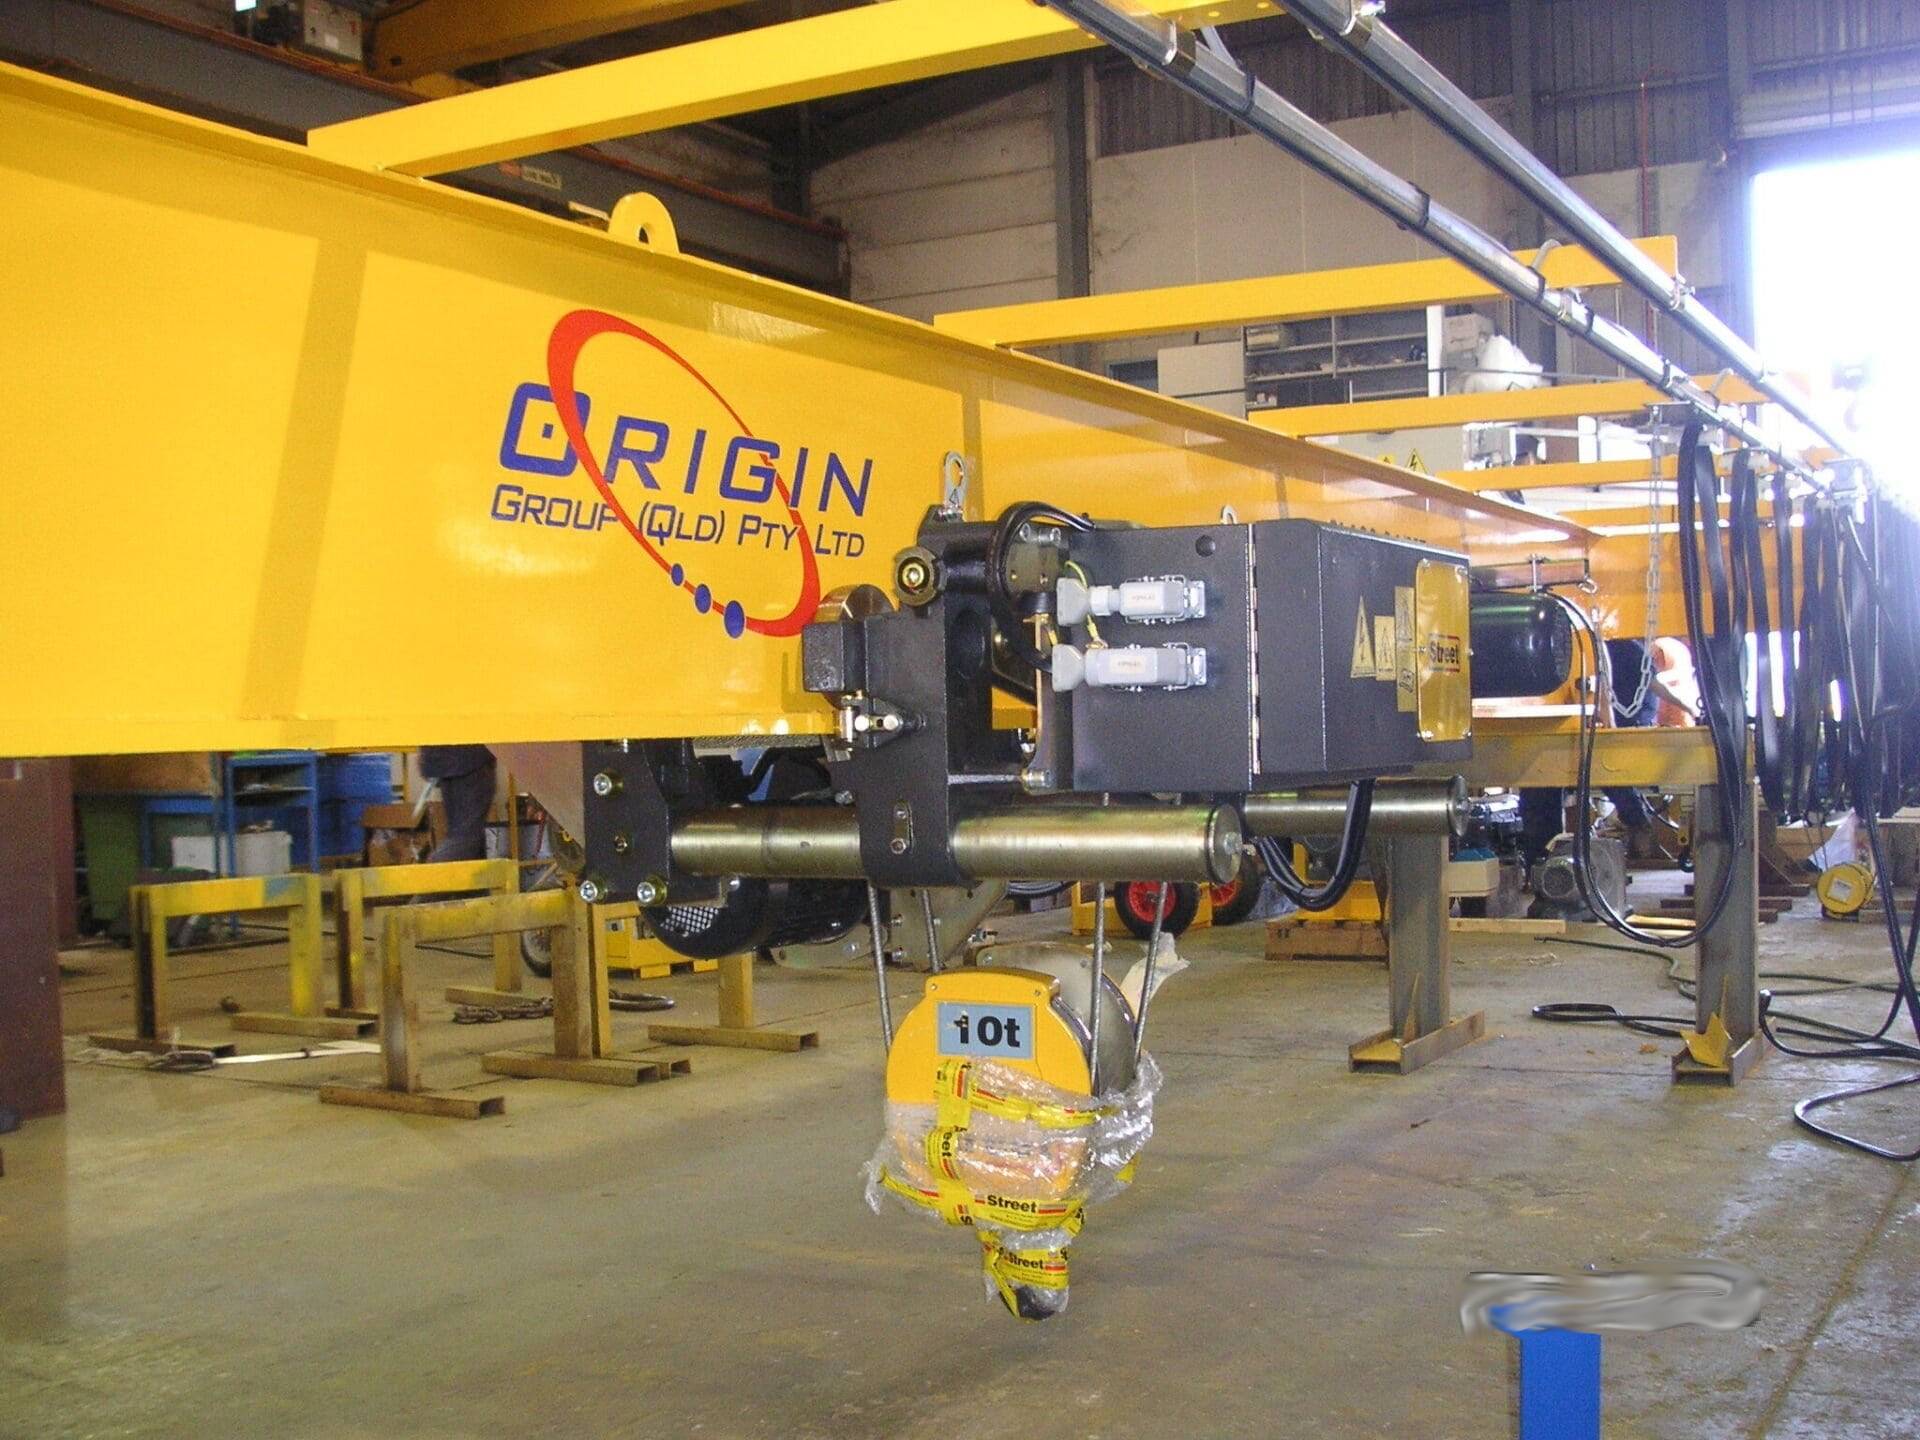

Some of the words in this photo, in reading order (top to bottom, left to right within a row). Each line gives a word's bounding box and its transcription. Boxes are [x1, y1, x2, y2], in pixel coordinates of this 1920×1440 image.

[500, 382, 873, 517] ORIGIN
[638, 502, 725, 546] (QLD)
[738, 515, 797, 550] PTY
[815, 524, 865, 557] LTD
[1429, 640, 1461, 665] Street
[954, 1014, 1020, 1048] 10t
[987, 1195, 1038, 1213] Street
[1009, 1252, 1044, 1269] Street
